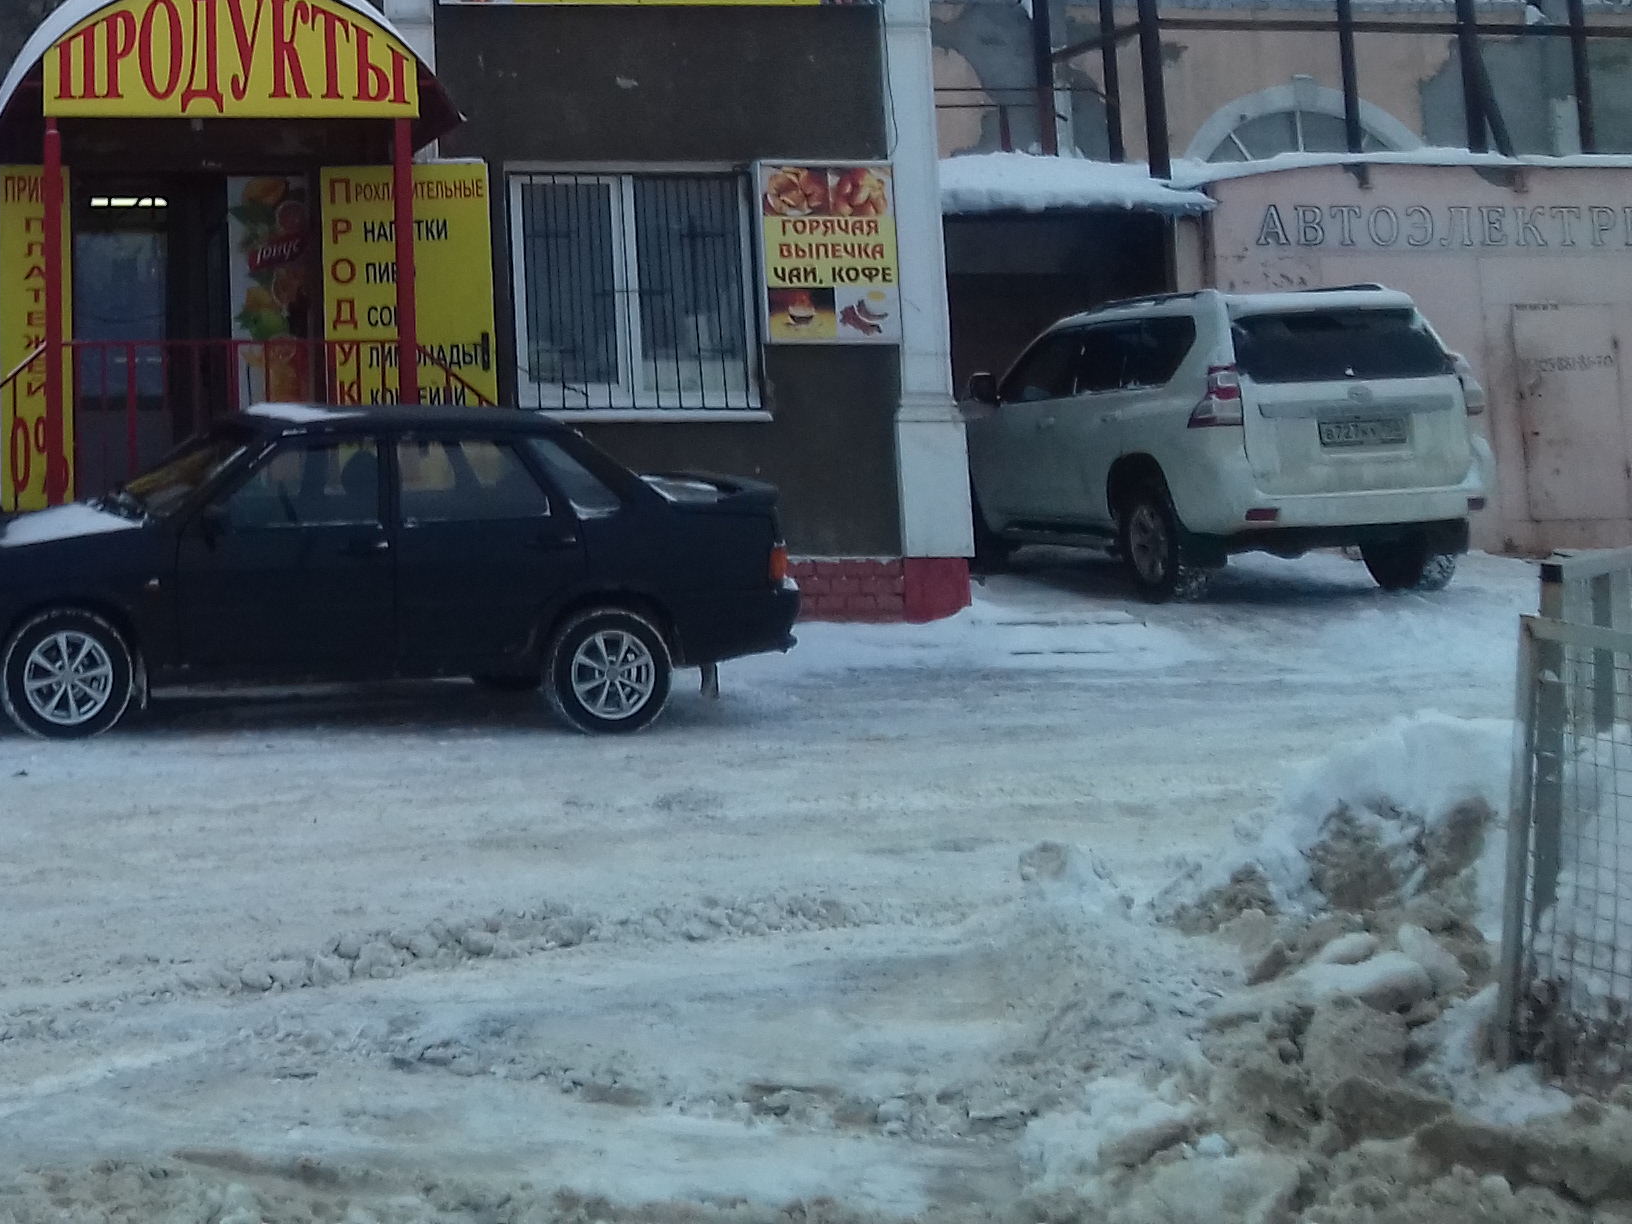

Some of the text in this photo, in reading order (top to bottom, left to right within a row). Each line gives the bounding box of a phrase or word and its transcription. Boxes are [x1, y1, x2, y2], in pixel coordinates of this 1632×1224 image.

[4, 176, 64, 203] ПРИ
[363, 219, 448, 242] НАТКИ
[780, 218, 879, 237] ГОРЯЧАЯ
[779, 242, 885, 261] ВЫПЕЧКА
[831, 267, 893, 283] КОФЕ
